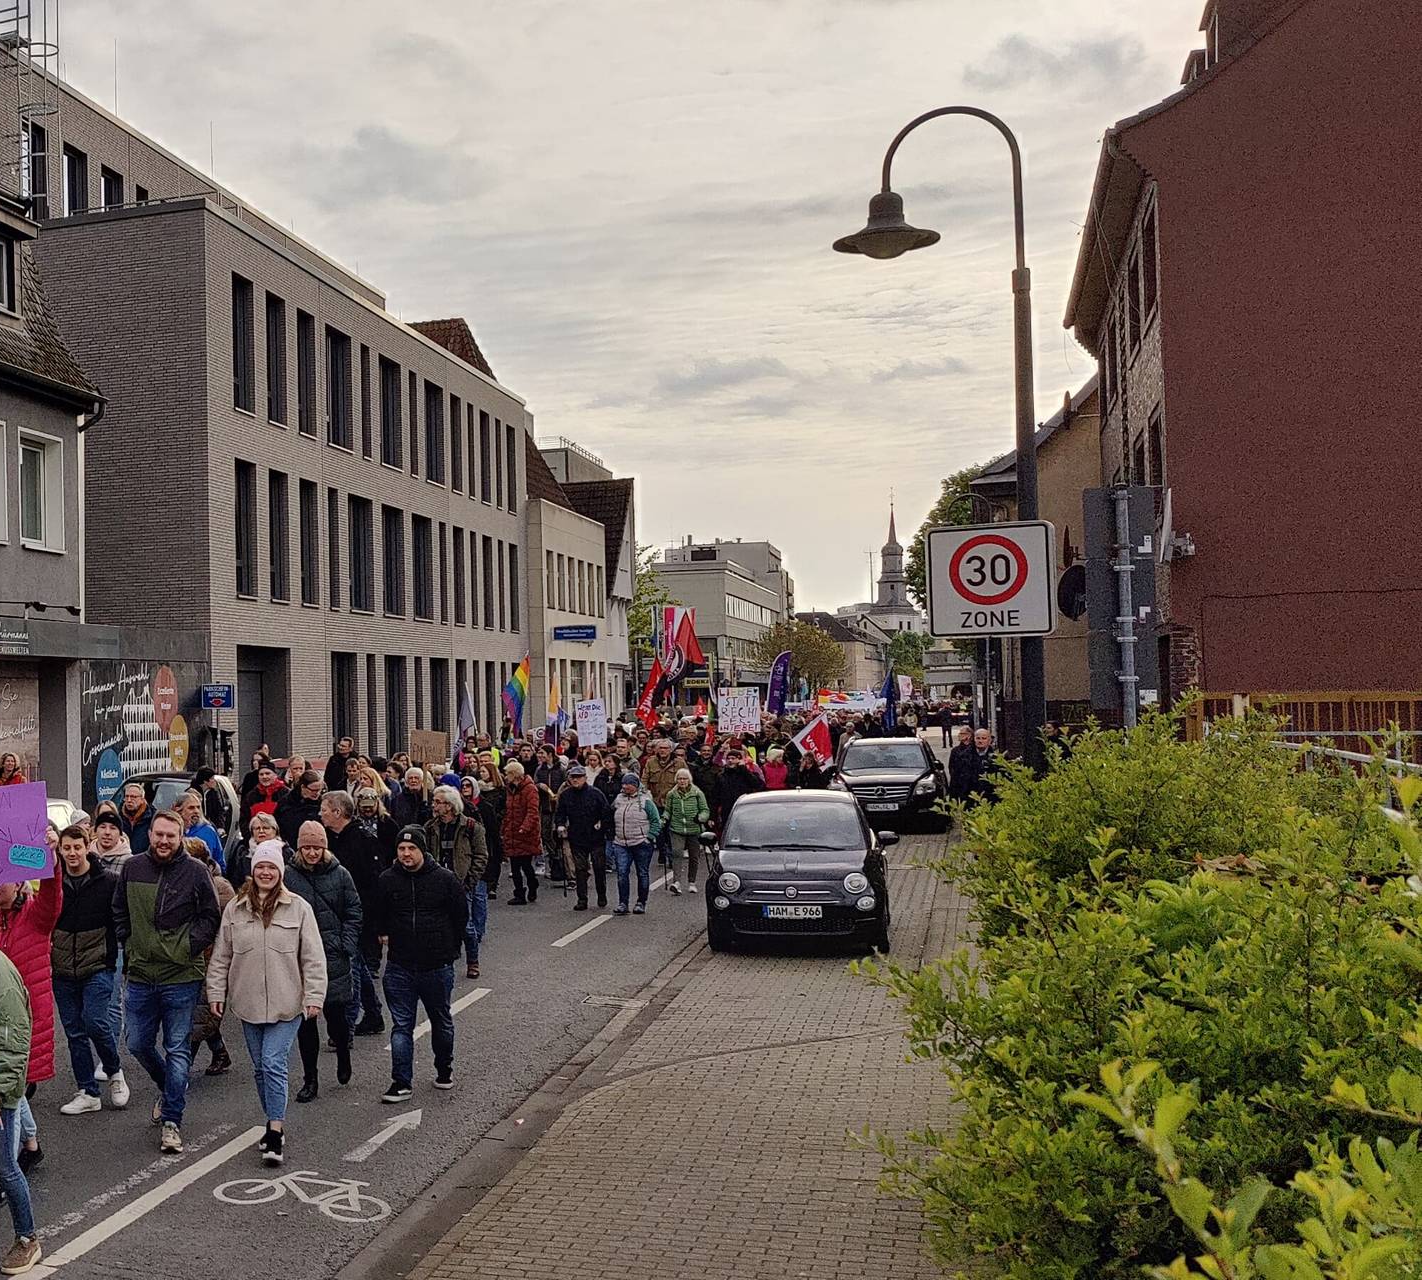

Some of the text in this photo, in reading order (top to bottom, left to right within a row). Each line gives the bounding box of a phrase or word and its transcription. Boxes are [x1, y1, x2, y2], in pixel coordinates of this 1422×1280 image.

[965, 553, 1012, 587] 30
[960, 609, 1020, 629] ZONE
[118, 661, 151, 692] Auswahl
[1, 682, 19, 710] Sie
[719, 688, 753, 697] LIEBE
[768, 904, 822, 917] HAM E 966
